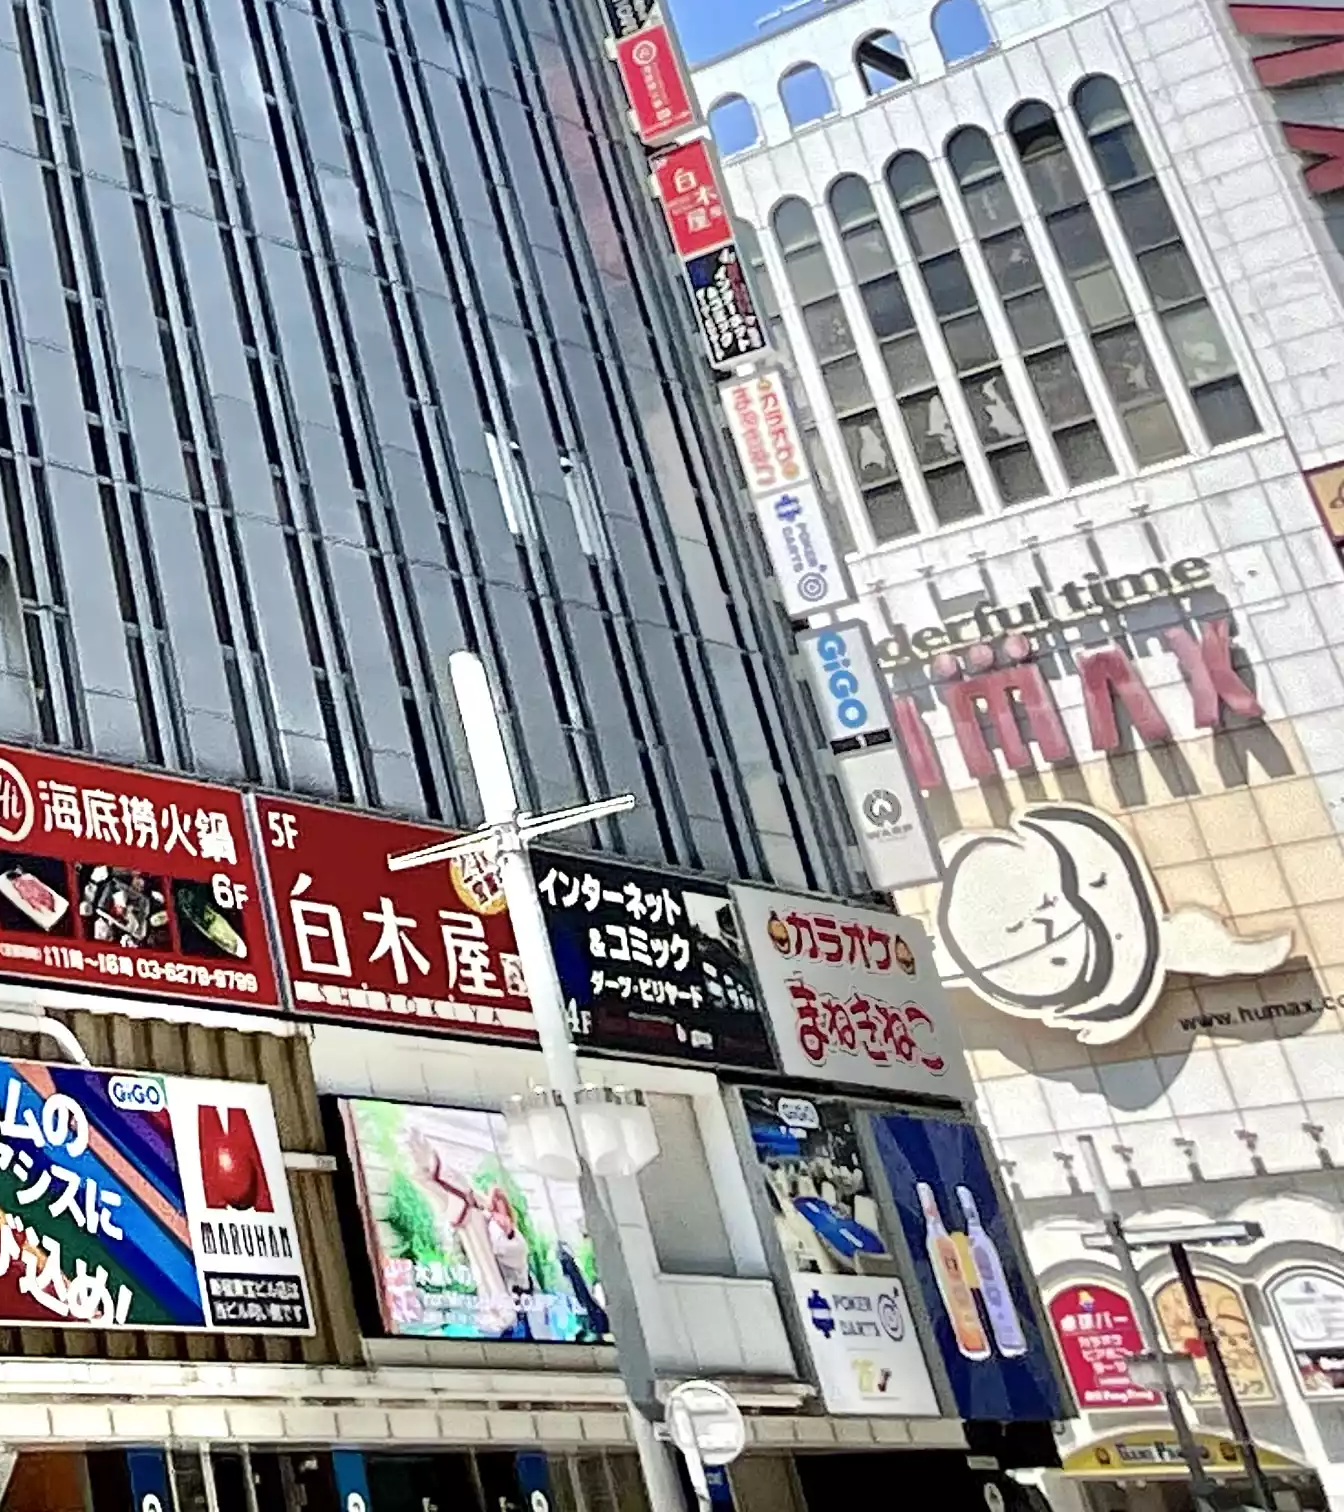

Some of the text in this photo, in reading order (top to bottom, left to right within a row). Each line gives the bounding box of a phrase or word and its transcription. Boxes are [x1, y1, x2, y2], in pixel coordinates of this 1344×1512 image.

[1067, 554, 1213, 622] time
[816, 630, 869, 729] GiGO
[267, 811, 300, 850] 5F
[211, 873, 250, 911] 6F
[539, 867, 682, 926] インターネット
[289, 871, 506, 999] 白木屋
[589, 924, 691, 972] &コミック
[786, 912, 892, 971] カラオケ
[786, 976, 946, 1075] まねきねこ
[200, 1221, 294, 1261] MARUHAN
